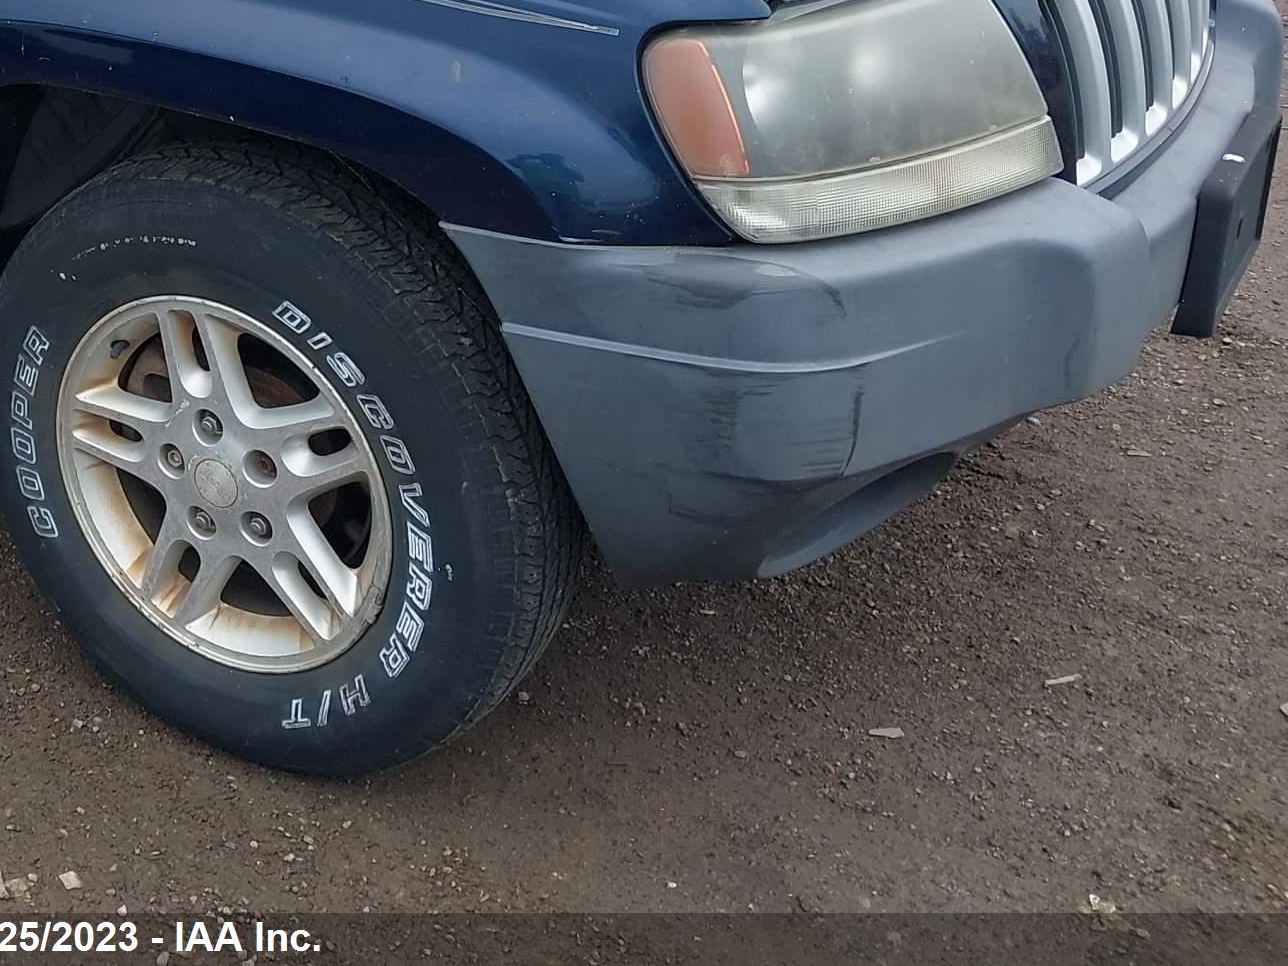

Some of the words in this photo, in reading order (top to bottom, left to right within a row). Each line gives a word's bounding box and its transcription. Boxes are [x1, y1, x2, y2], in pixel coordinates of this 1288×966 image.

[11, 324, 59, 538] COOPER
[271, 299, 434, 679] DISCOVERER
[281, 673, 372, 730] H/T
